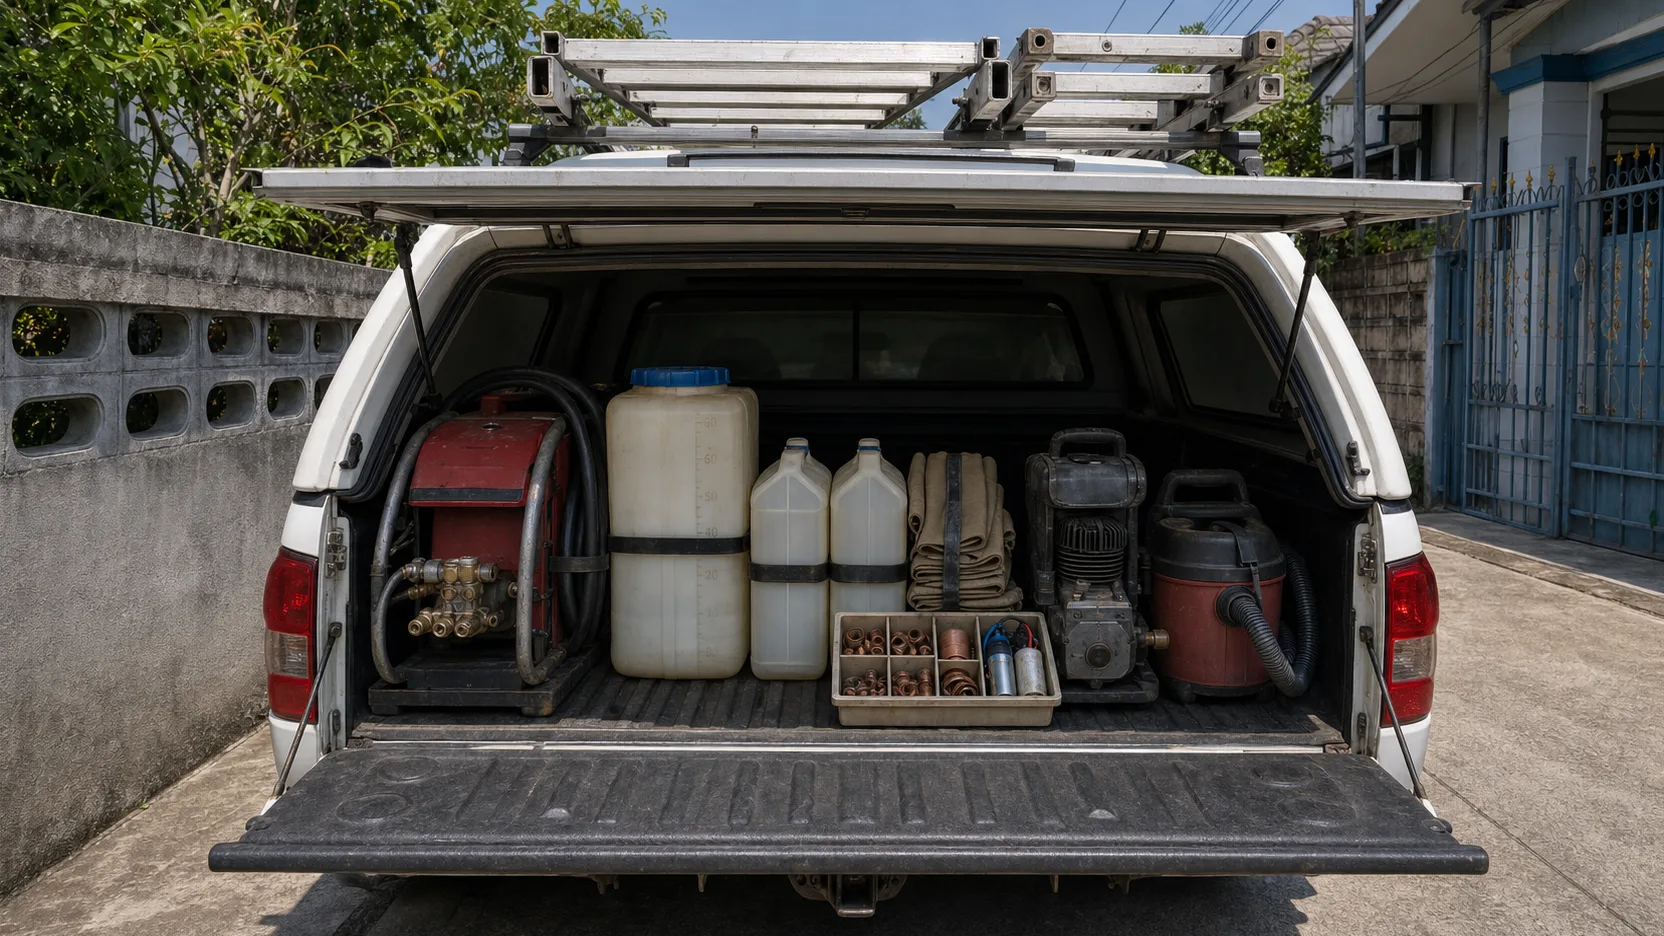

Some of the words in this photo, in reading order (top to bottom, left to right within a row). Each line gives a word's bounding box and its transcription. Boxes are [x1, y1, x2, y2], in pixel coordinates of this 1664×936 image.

[704, 453, 717, 465] 60
[704, 491, 718, 502] 50
[704, 569, 719, 580] 20
